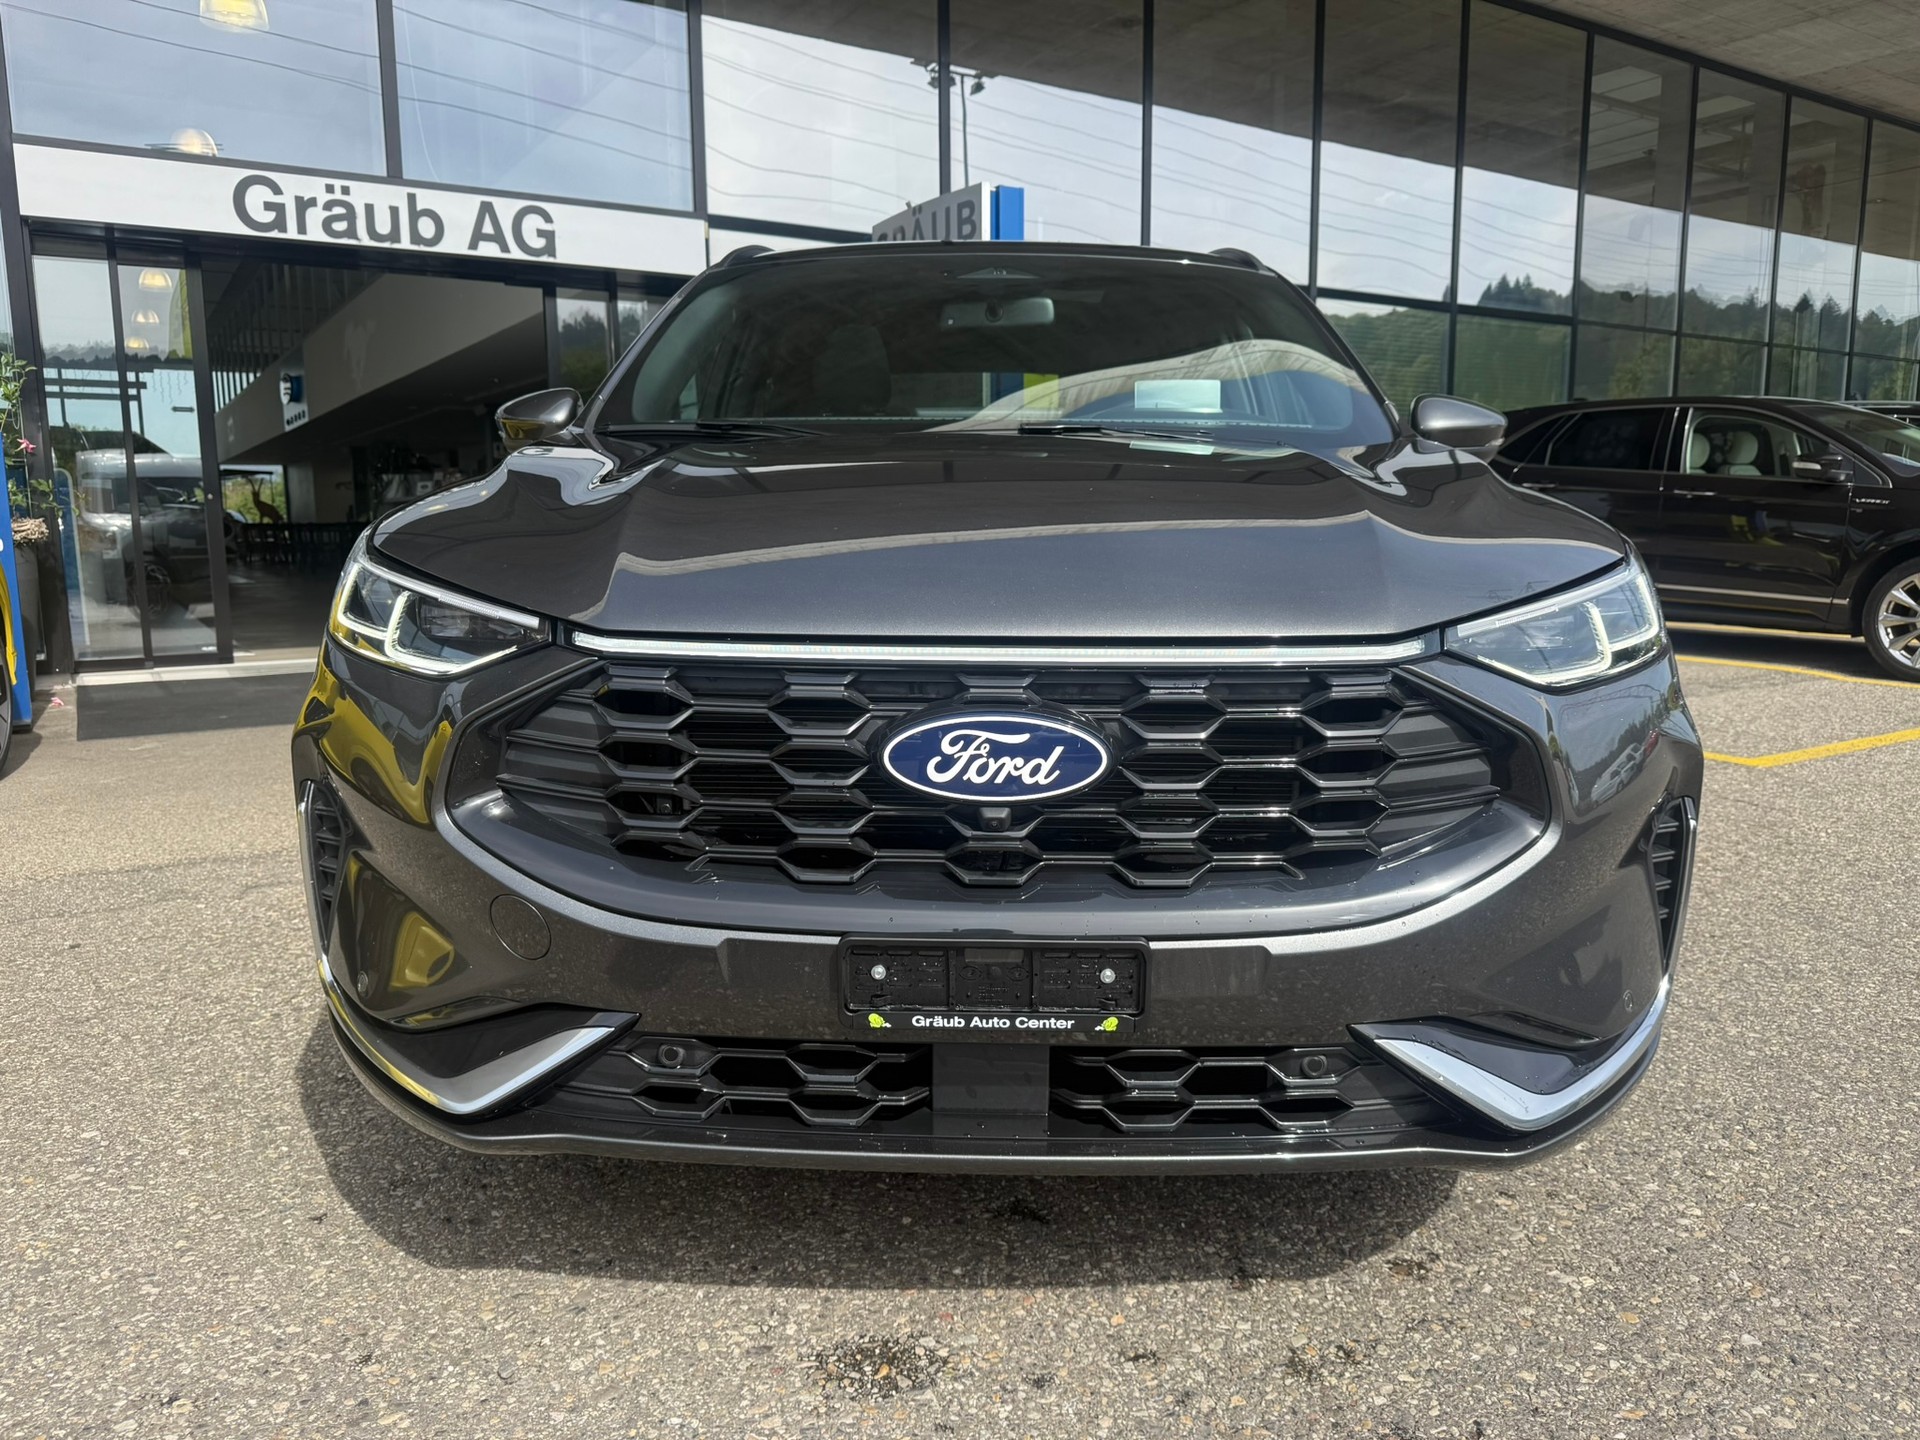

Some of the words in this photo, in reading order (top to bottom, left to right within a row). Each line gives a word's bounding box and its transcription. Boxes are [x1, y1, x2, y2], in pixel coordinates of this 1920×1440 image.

[232, 174, 445, 248] Gräub
[467, 200, 557, 259] AG
[926, 729, 1065, 785] Ford
[911, 1015, 966, 1028] Gräub
[969, 1016, 1010, 1029] Auto
[1015, 1016, 1075, 1029] Center
